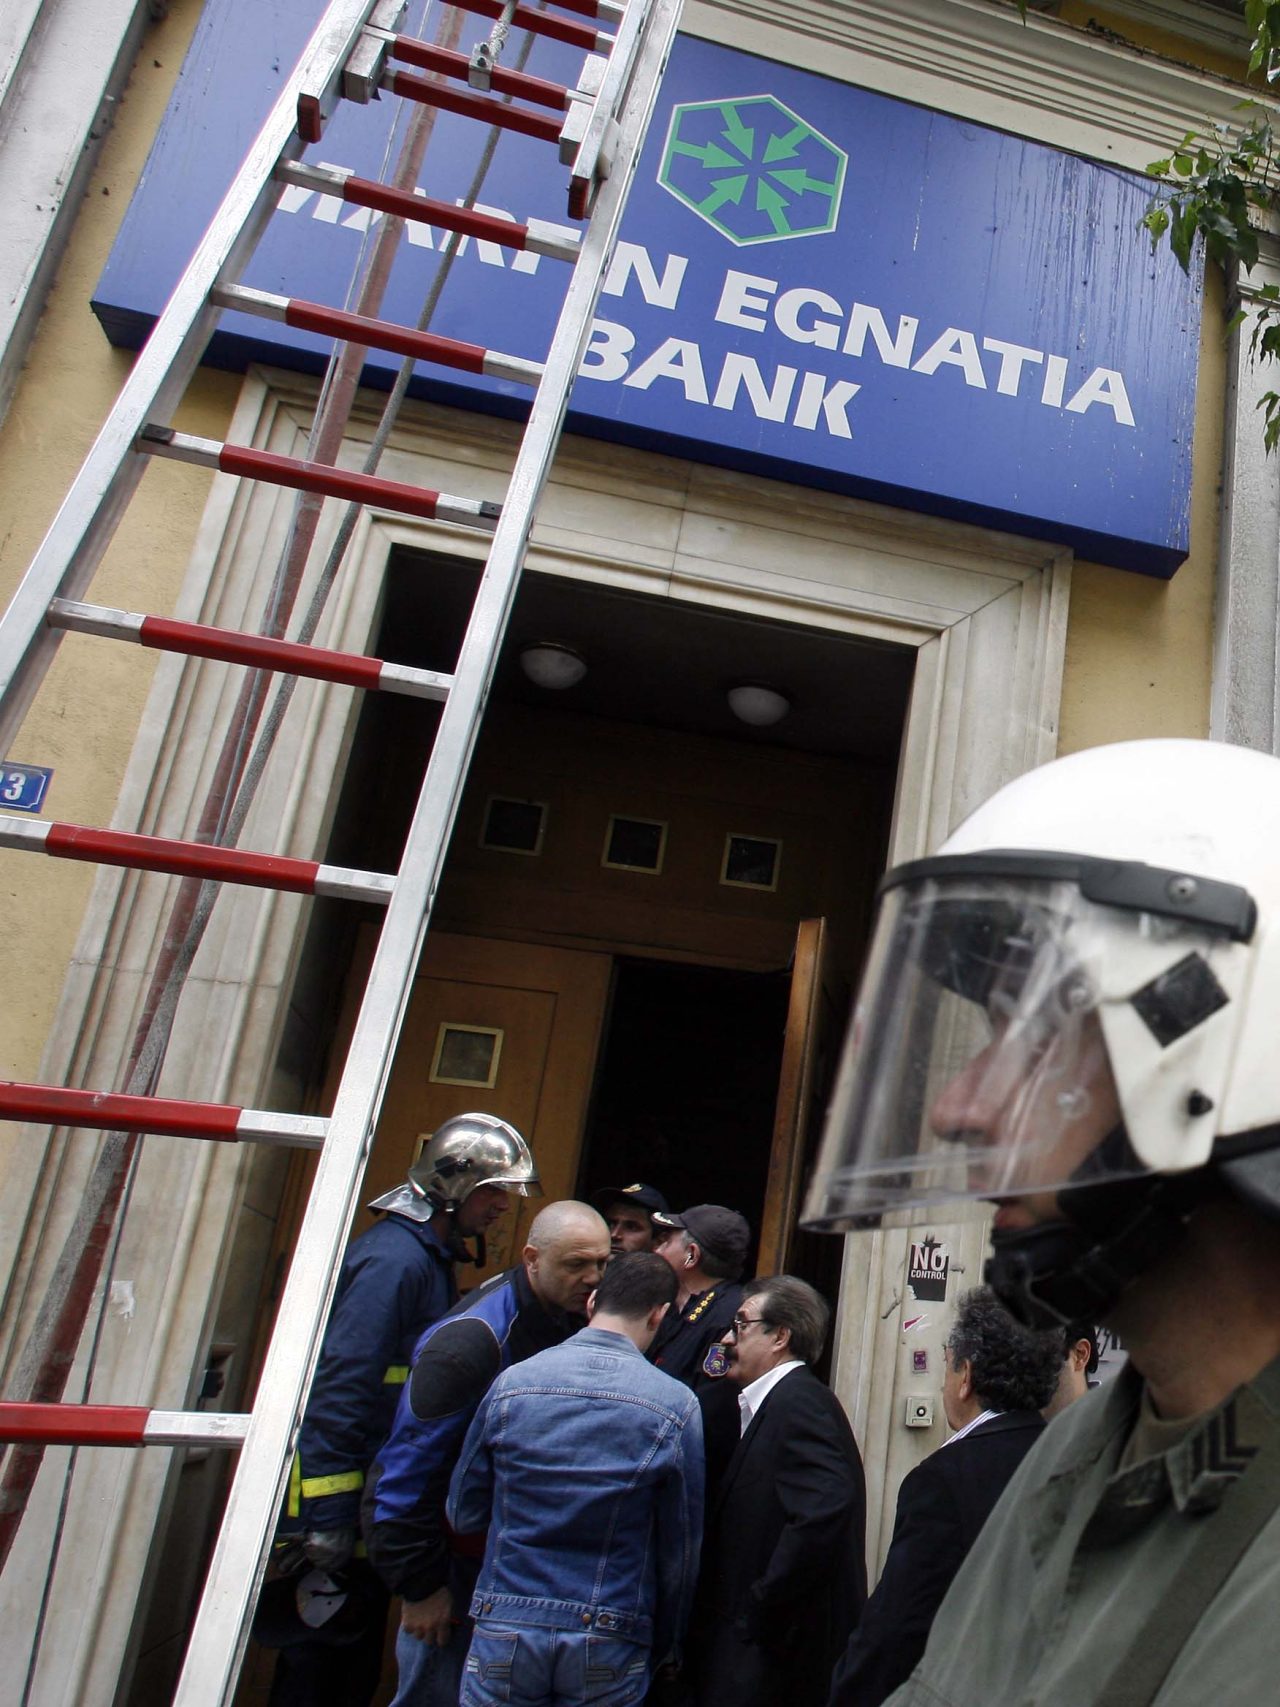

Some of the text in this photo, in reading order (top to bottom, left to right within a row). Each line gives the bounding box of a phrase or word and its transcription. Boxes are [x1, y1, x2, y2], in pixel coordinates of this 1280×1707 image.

[577, 319, 861, 440] BANK
[714, 270, 1136, 427] EGNATIA
[910, 1269, 947, 1280] CONTROL
[913, 1245, 947, 1272] NO
